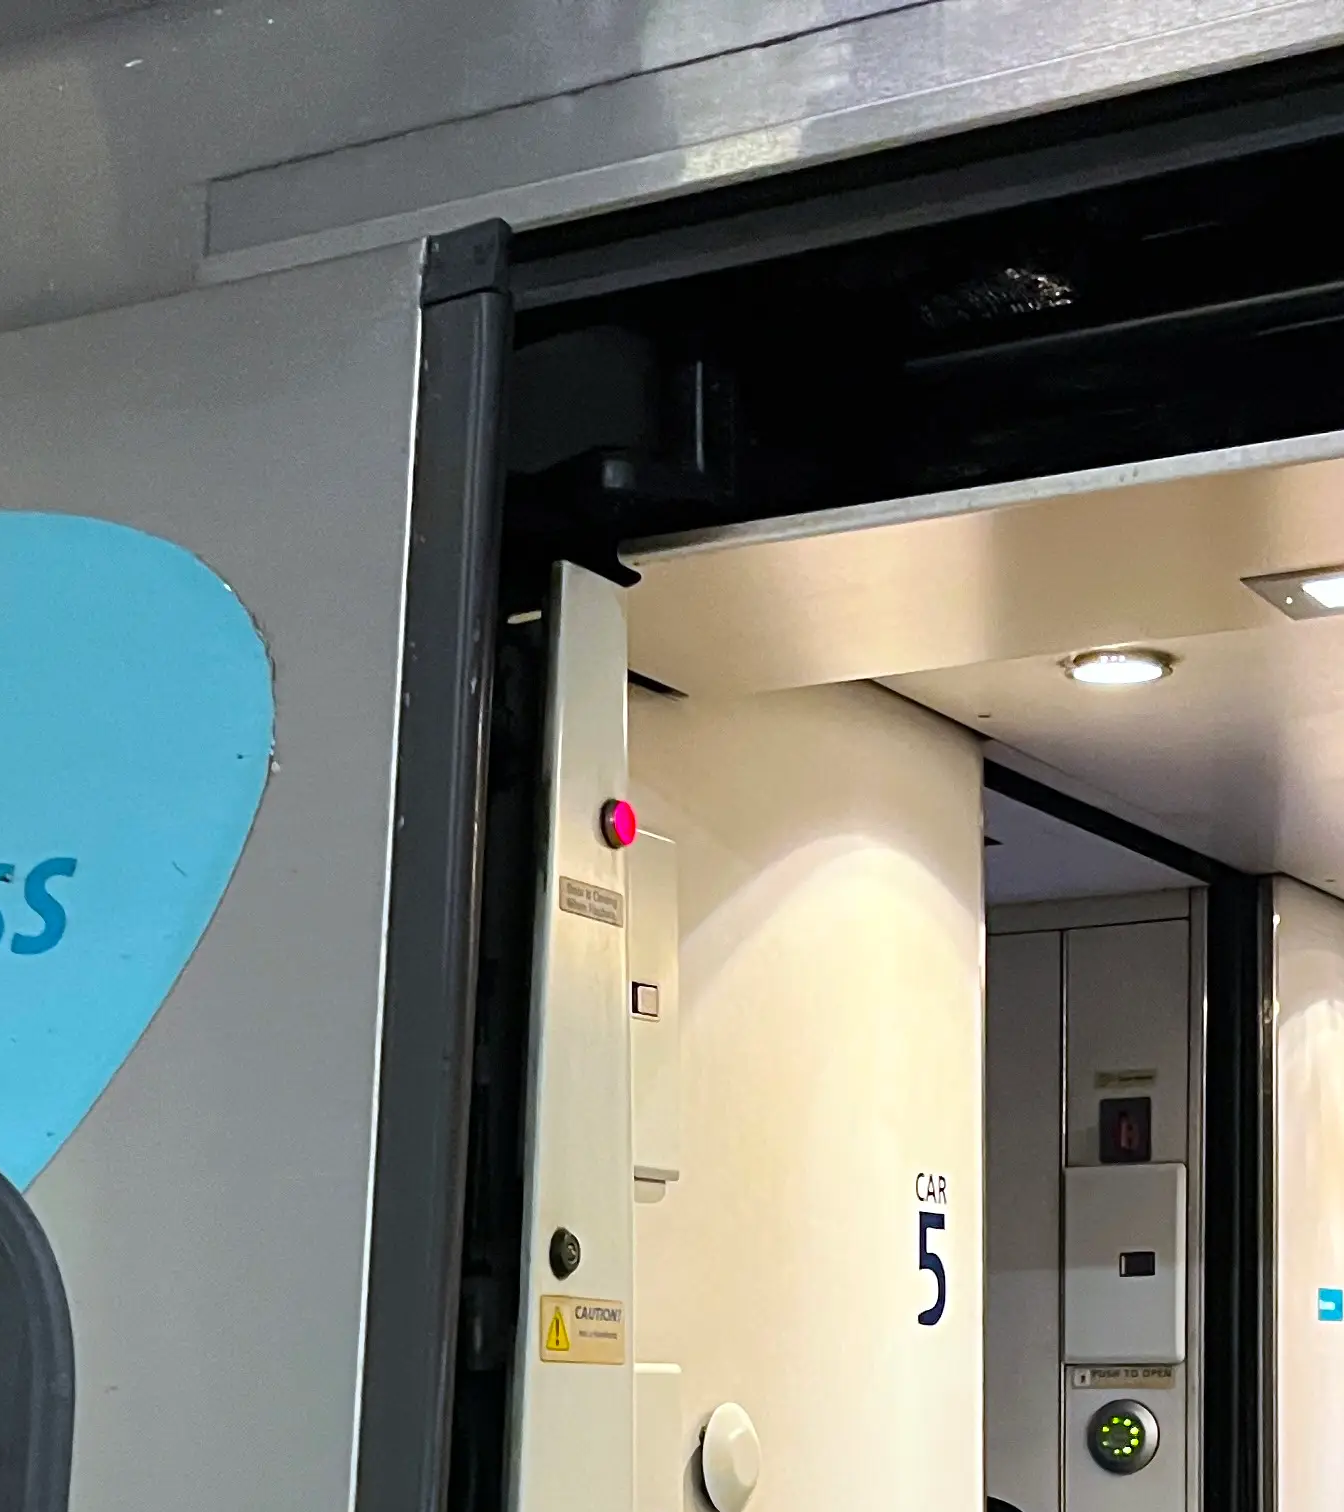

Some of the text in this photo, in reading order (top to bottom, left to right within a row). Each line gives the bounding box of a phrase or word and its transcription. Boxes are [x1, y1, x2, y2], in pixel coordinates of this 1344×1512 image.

[915, 1172, 947, 1204] CAR
[917, 1211, 946, 1326] 5
[1123, 1368, 1139, 1378] TO
[1142, 1368, 1172, 1378] OPEN
